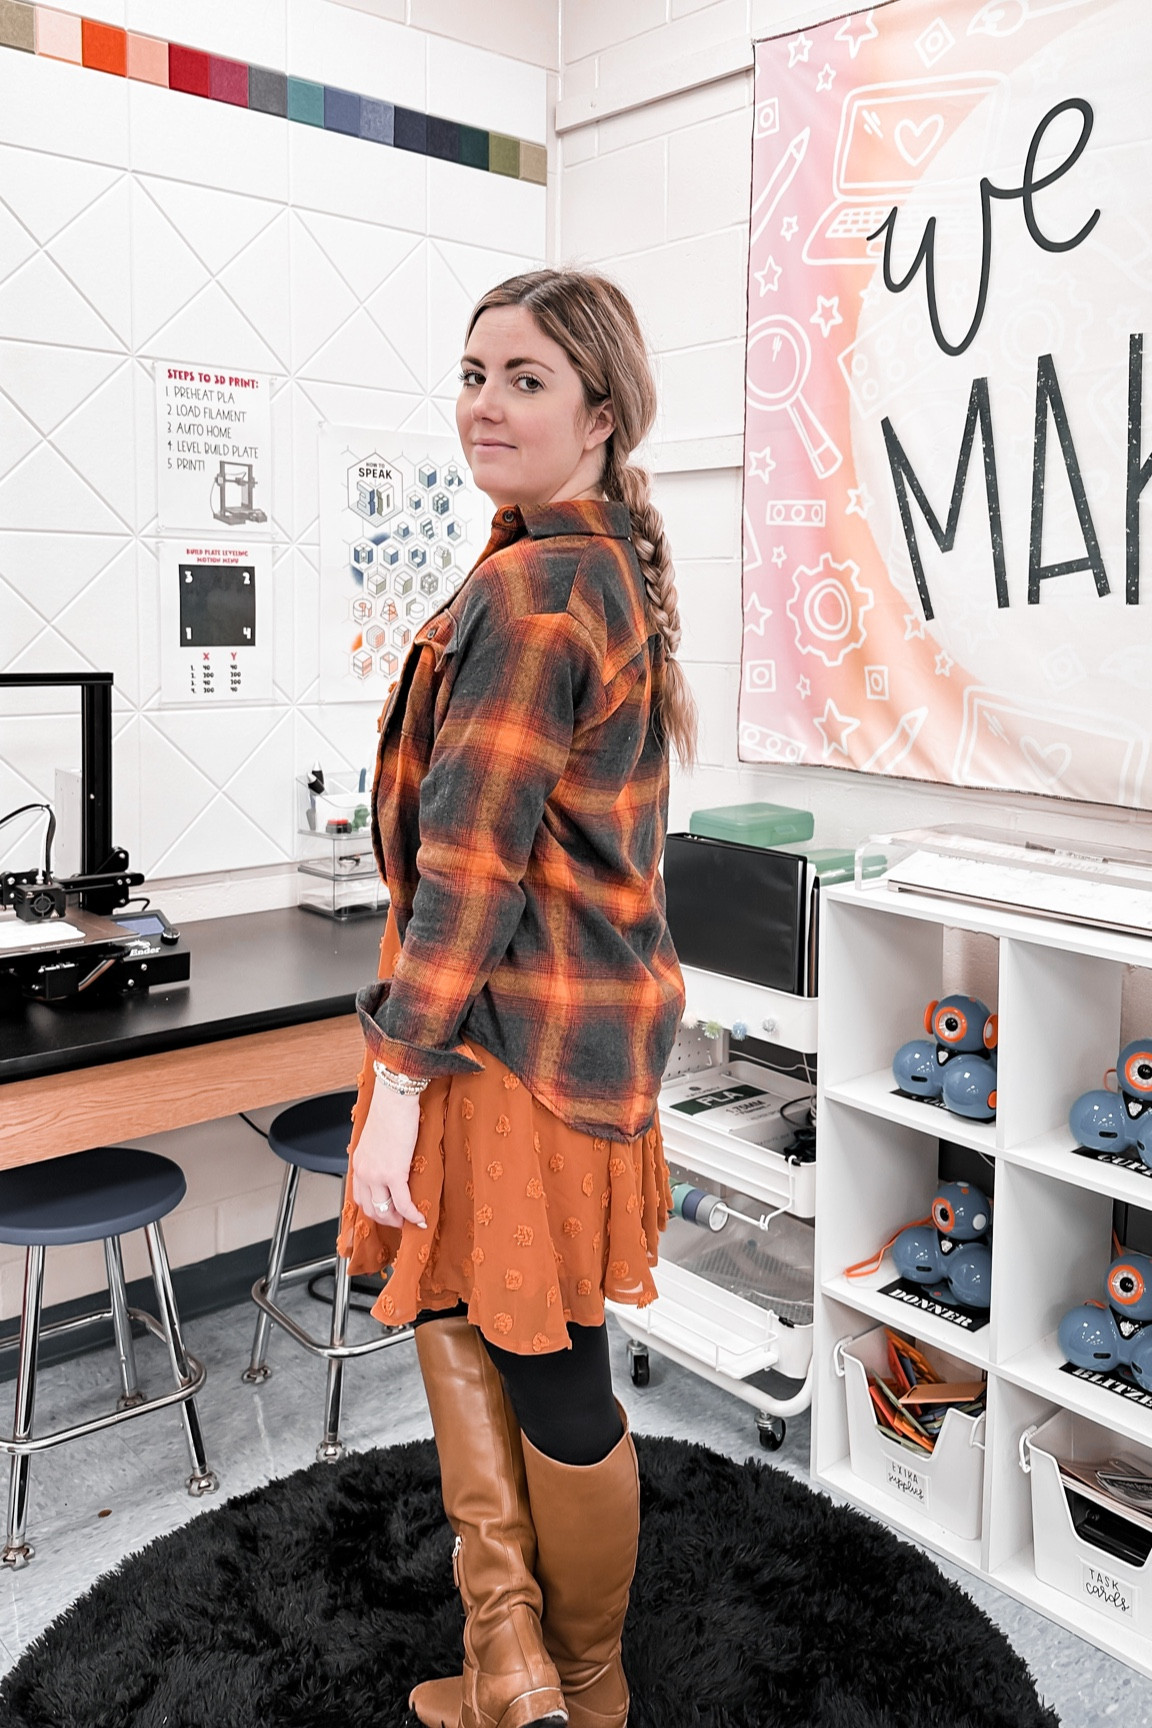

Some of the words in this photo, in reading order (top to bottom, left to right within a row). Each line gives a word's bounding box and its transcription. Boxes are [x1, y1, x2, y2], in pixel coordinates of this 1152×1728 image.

[866, 97, 1101, 356] we
[167, 368, 195, 382] STEPS
[198, 372, 211, 383] TO
[214, 375, 226, 385] 3D
[228, 376, 258, 389] PRINT:
[174, 385, 214, 402] PREHEAT
[217, 390, 235, 404] PLA
[176, 404, 201, 418] LOAD
[203, 407, 247, 423] FILAMENT
[176, 422, 204, 436] AUTO
[206, 425, 232, 439] HOME
[177, 440, 201, 454] LEVEL
[204, 442, 230, 457] BUILD
[232, 445, 259, 459] PLATE
[358, 467, 392, 480] SPEAK
[184, 570, 193, 584] 3
[242, 572, 251, 585] 2
[185, 627, 192, 640] 1
[243, 627, 252, 640] 4
[203, 652, 210, 661] X
[231, 651, 237, 661] Y
[129, 946, 161, 957] Ender
[696, 1090, 744, 1106] PLA
[888, 1288, 973, 1328] DONNER
[1089, 1568, 1119, 1591] TASK
[1085, 1582, 1130, 1612] cards
